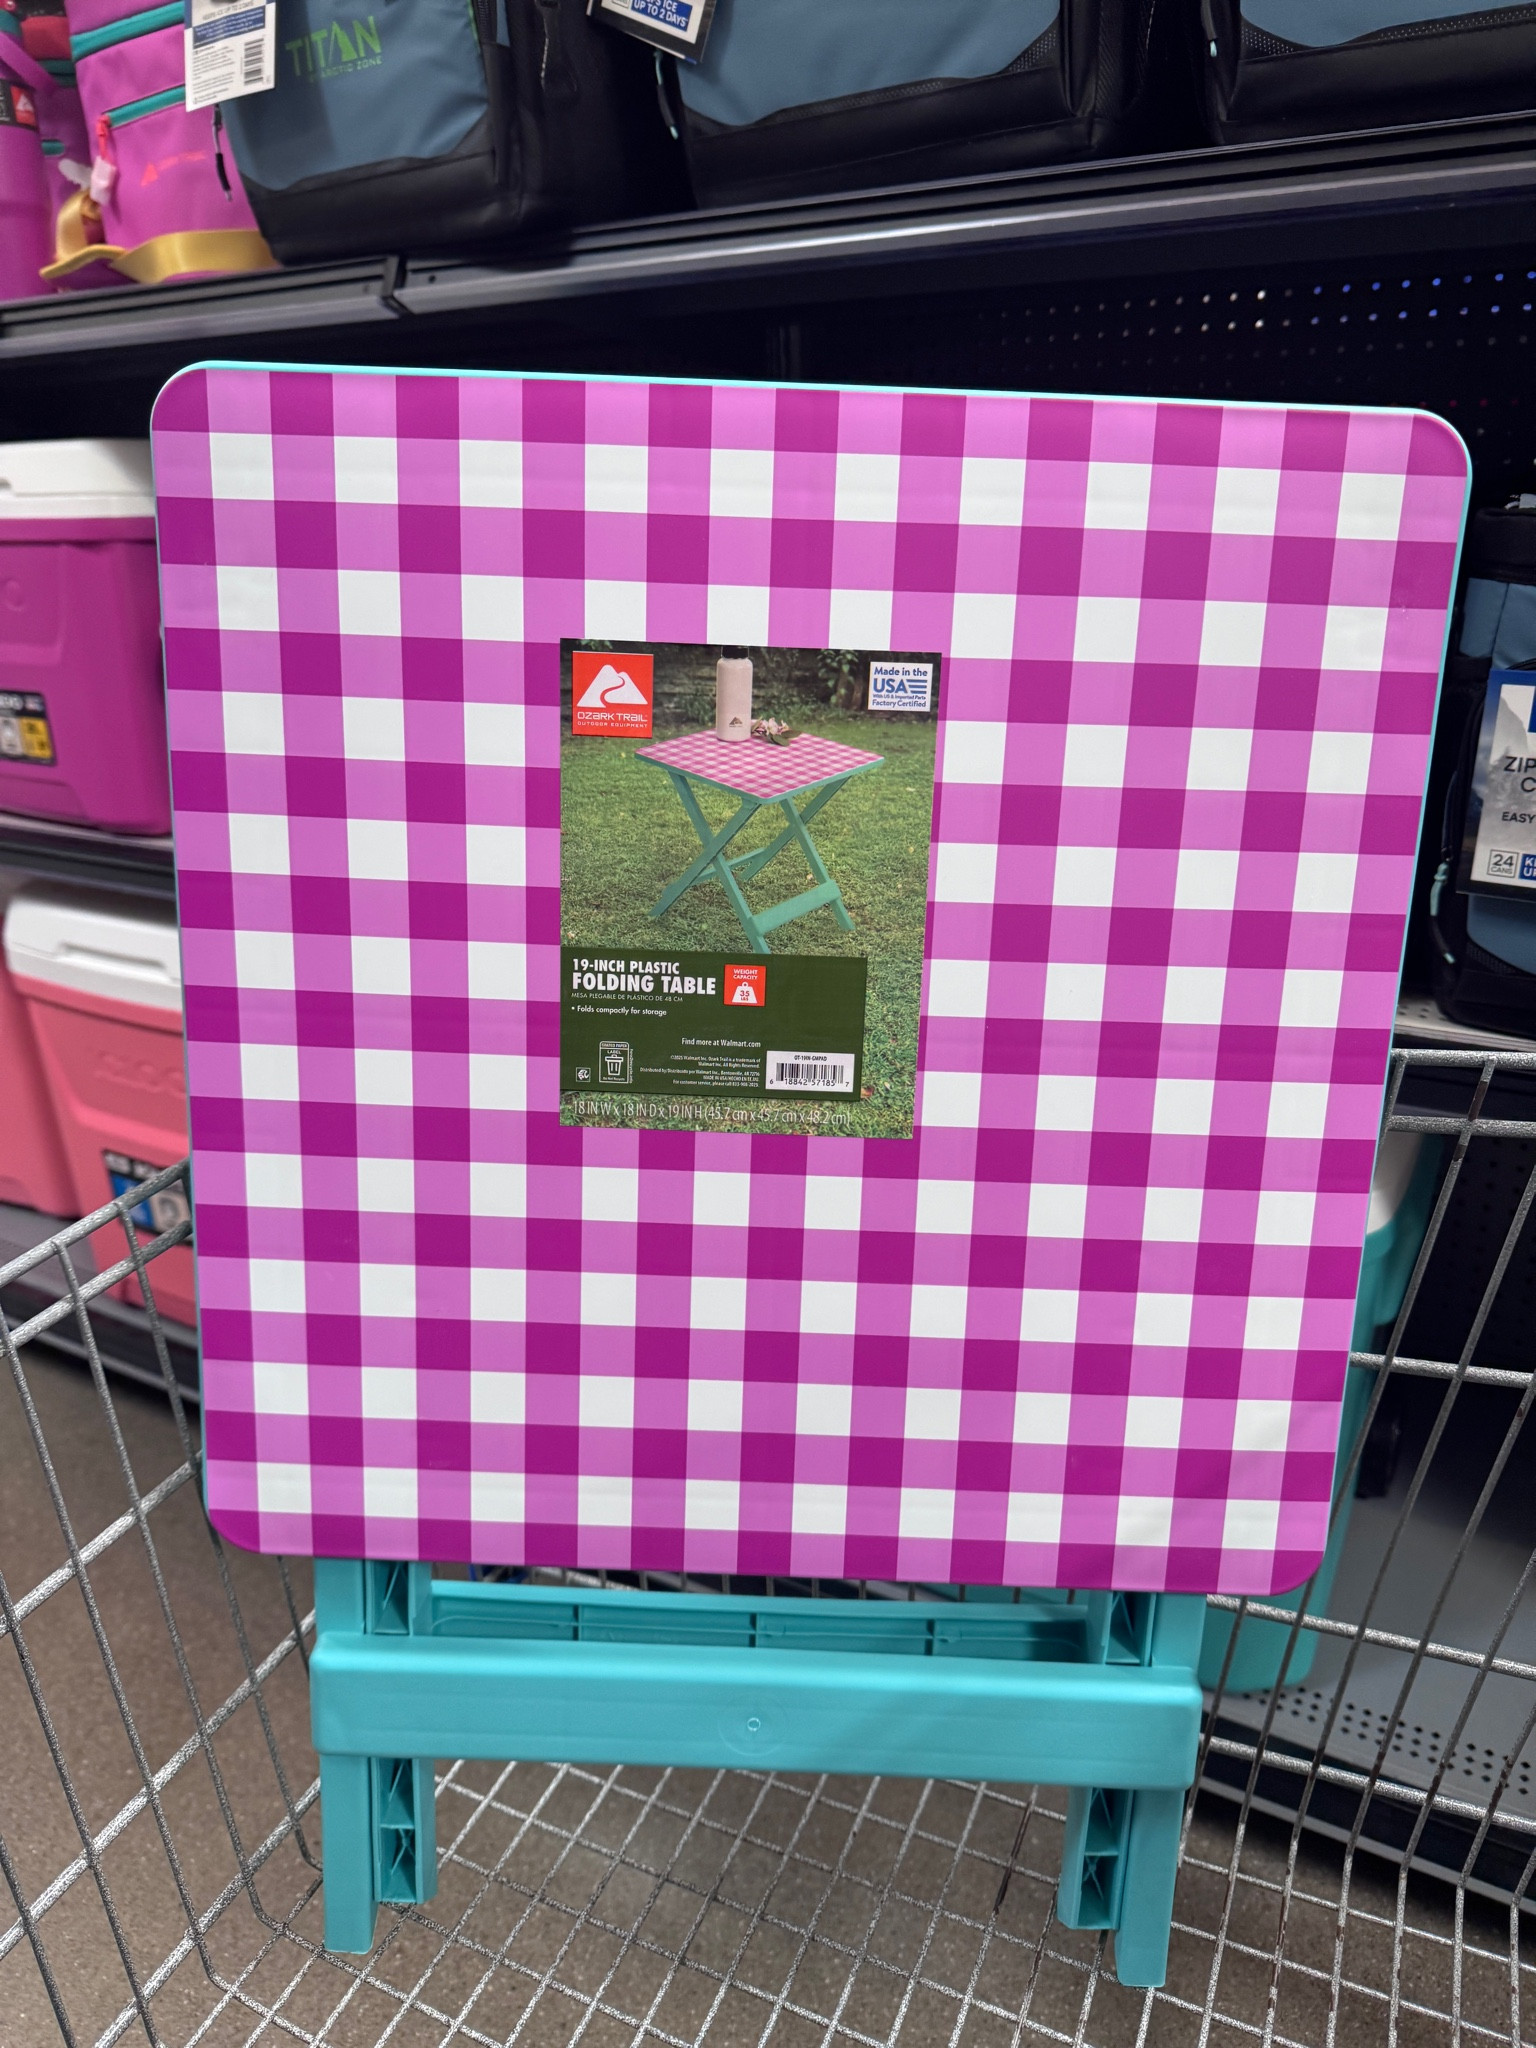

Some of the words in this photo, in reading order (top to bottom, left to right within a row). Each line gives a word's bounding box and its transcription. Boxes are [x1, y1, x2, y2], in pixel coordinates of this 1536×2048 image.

[647, 3, 658, 16] TO
[659, 8, 666, 19] 2
[665, 11, 687, 27] DAYS
[285, 15, 382, 76] TITAN
[874, 666, 900, 676] Made
[902, 667, 910, 676] in
[913, 667, 928, 677] the
[873, 678, 908, 694] USA
[872, 699, 897, 708] Factory
[897, 700, 927, 708] Certified
[1502, 811, 1536, 823] EASY
[1492, 853, 1514, 867] 24
[573, 958, 625, 972] 19-INCH
[630, 960, 680, 974] PLASTIC
[572, 972, 655, 993] FOLDING
[660, 976, 716, 995] TABLE
[577, 1005, 595, 1013] Folds
[596, 1006, 629, 1016] compactly
[631, 1006, 640, 1014] for
[642, 1008, 667, 1017] storage
[681, 1038, 695, 1046] Find
[720, 1039, 761, 1048] Walmart.com
[784, 1078, 808, 1086] 18842
[811, 1079, 836, 1087] 57185
[574, 1101, 585, 1115] 18
[587, 1101, 598, 1116] IN
[600, 1102, 612, 1117] W
[623, 1103, 634, 1117] 18
[636, 1103, 647, 1118] IN
[649, 1104, 657, 1118] D
[668, 1104, 679, 1118] 19
[681, 1104, 692, 1119] IN
[694, 1105, 702, 1119] H
[732, 1110, 748, 1120] cm
[781, 1111, 797, 1122] cm
